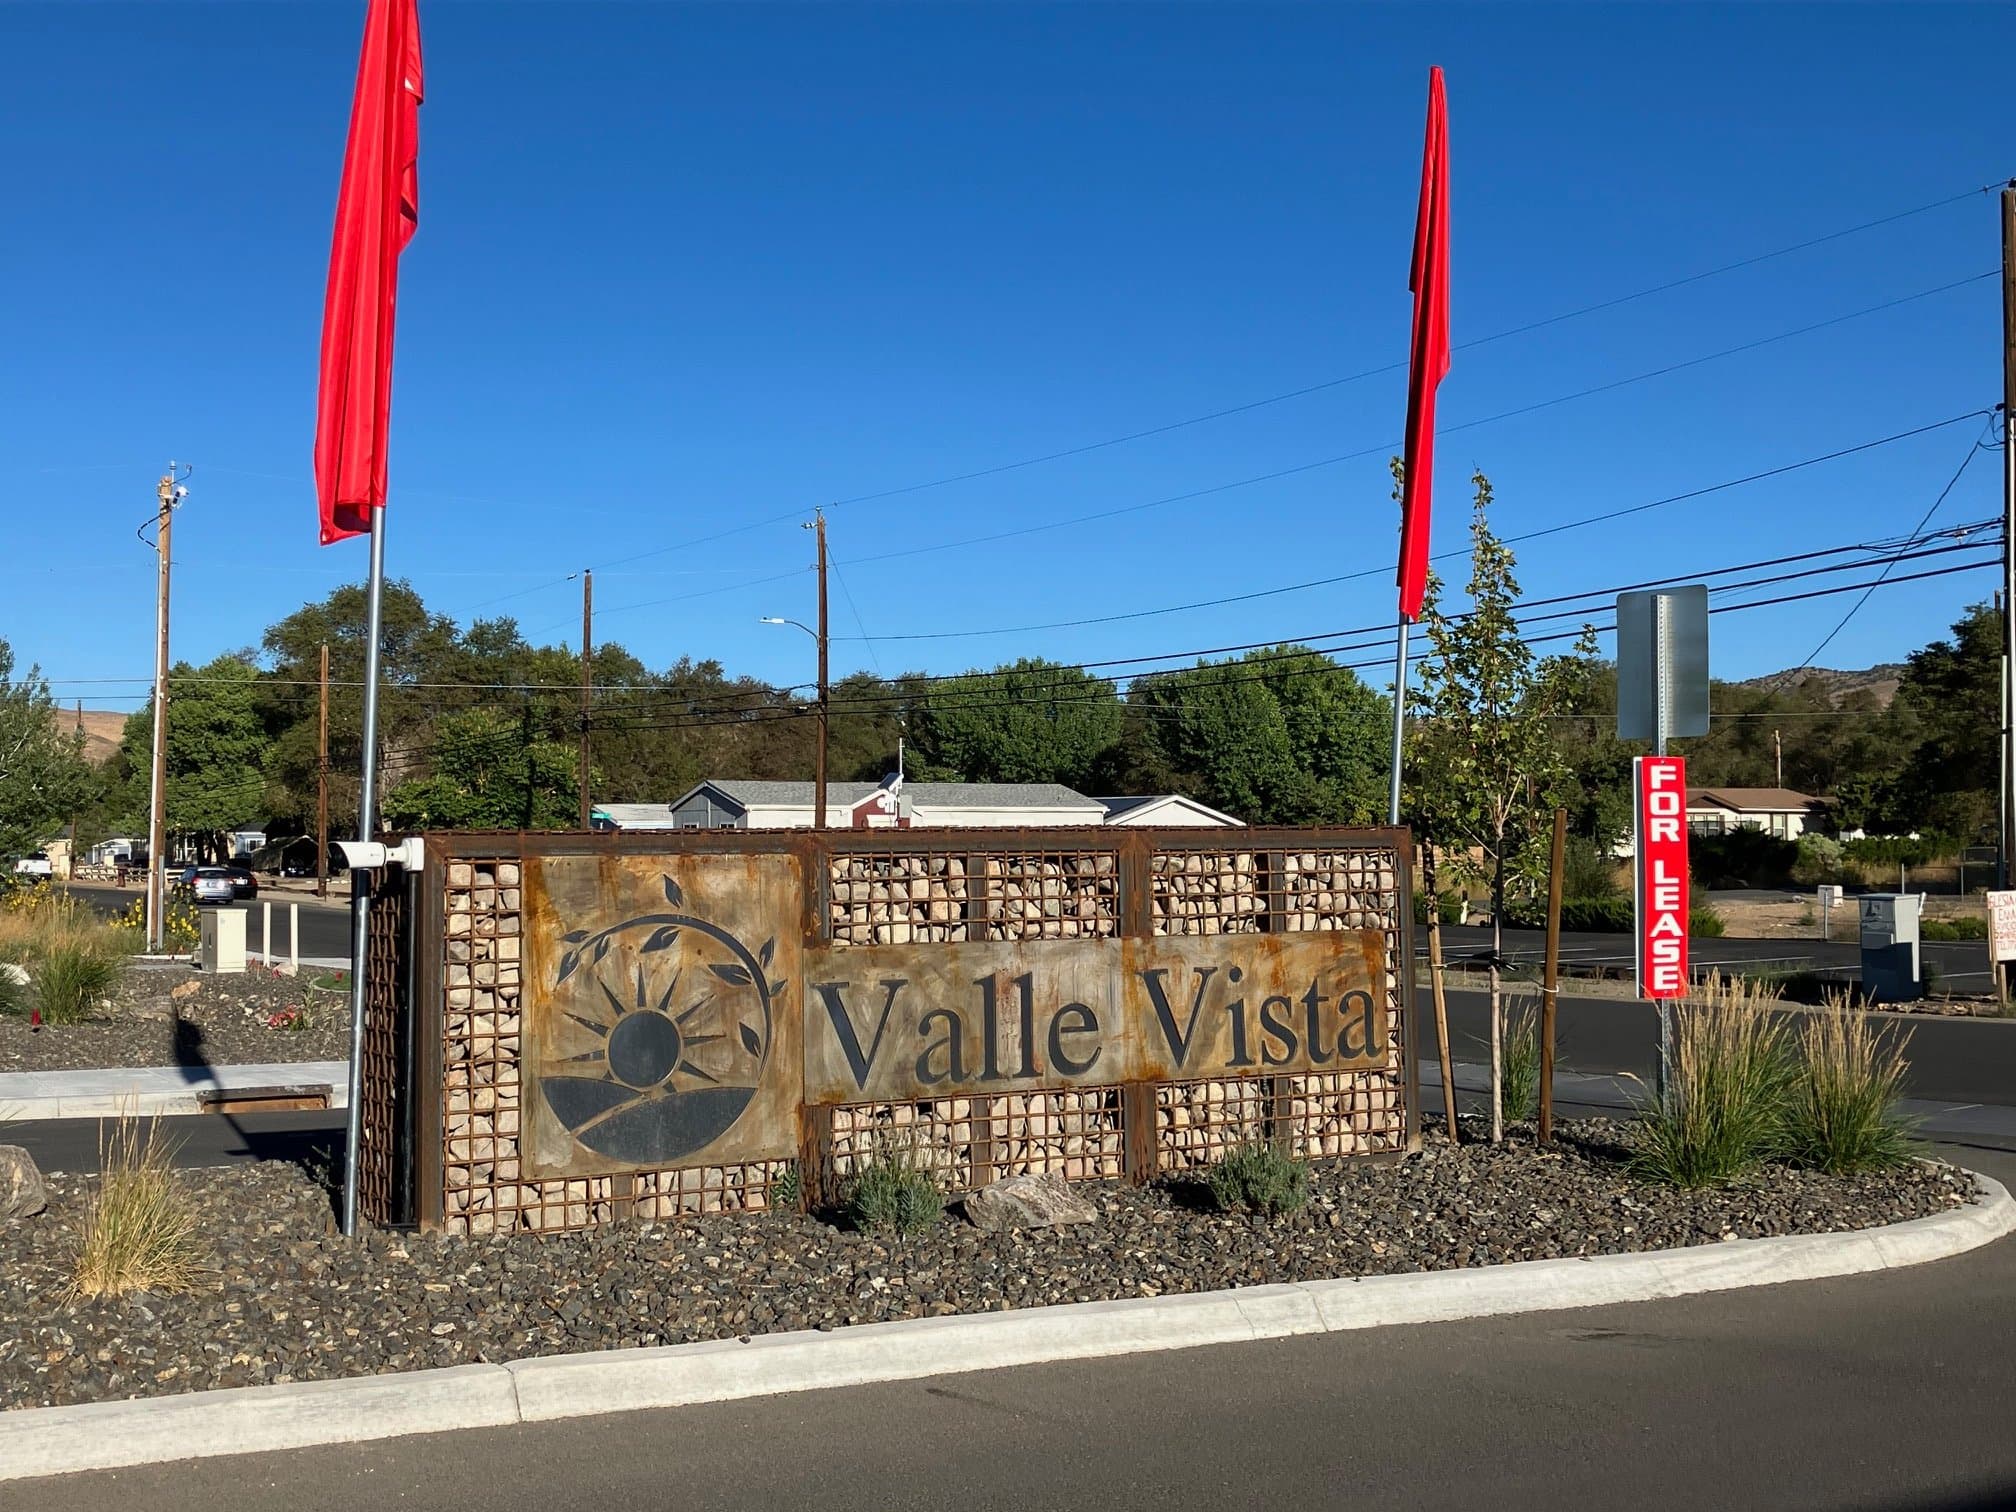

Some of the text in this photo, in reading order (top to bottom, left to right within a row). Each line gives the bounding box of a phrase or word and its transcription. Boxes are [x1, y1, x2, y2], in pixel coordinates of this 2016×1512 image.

[1650, 765, 1684, 991] FOR LEASE
[809, 966, 1383, 1091] Valle Vista
